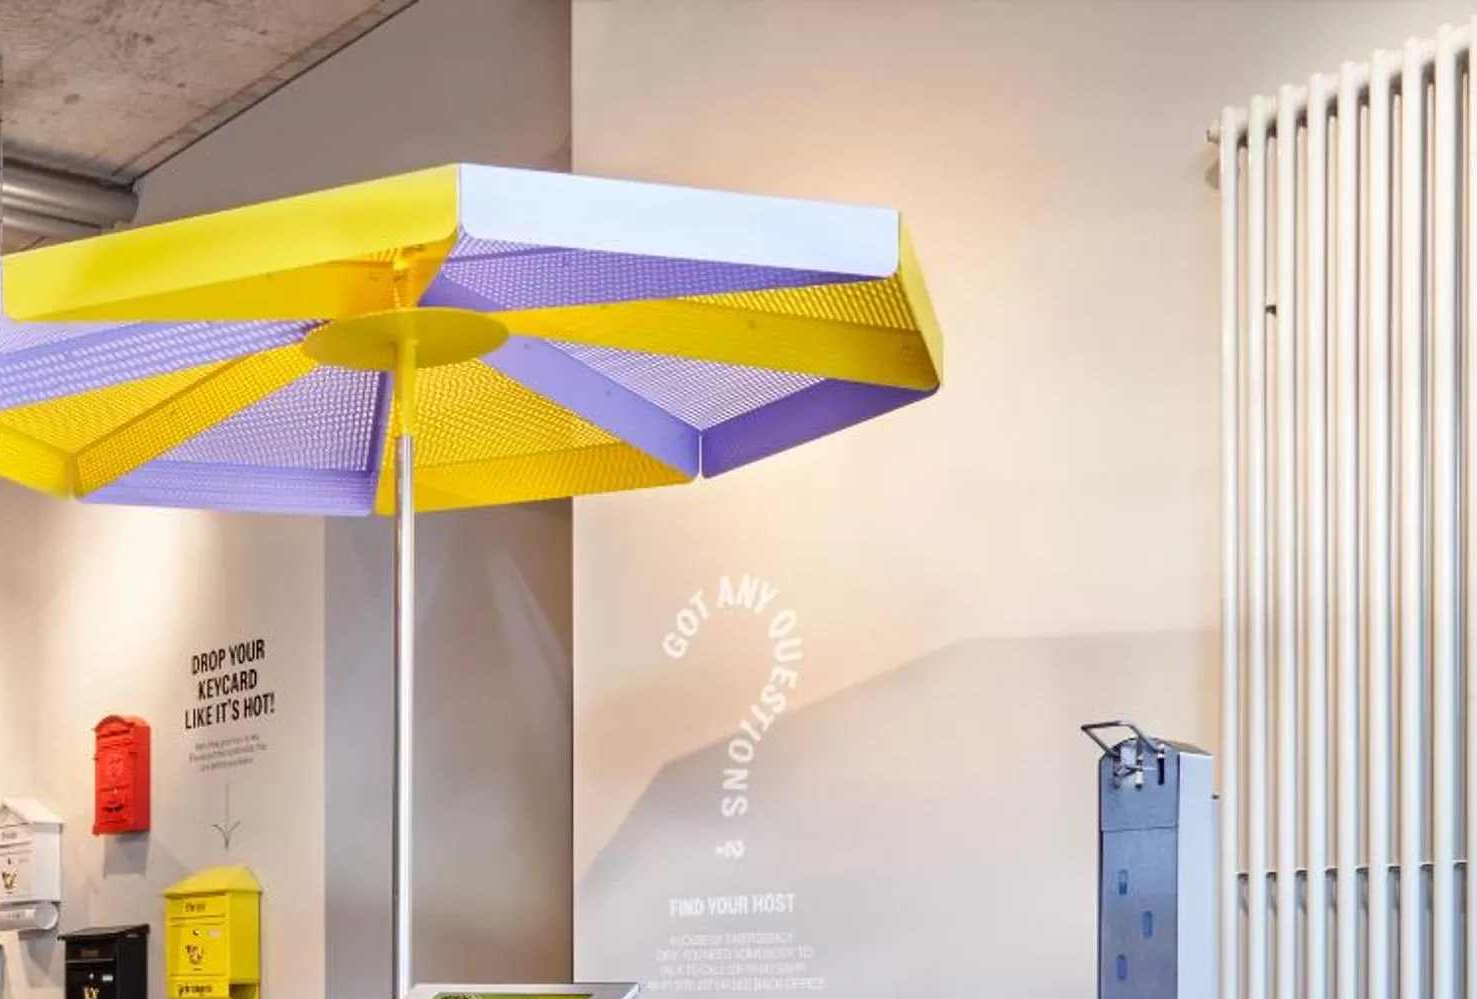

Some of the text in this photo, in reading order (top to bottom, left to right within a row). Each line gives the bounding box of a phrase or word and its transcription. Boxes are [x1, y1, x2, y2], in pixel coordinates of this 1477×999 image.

[716, 573, 781, 616] ANY
[662, 588, 710, 660] GOT
[191, 639, 266, 675] DROP YOUR
[198, 668, 258, 701] KEYCARD
[185, 691, 275, 730] LIKE IT'S HOT!
[721, 609, 804, 817] QUESTIONS
[670, 891, 796, 917] FIND YOUR HOST
